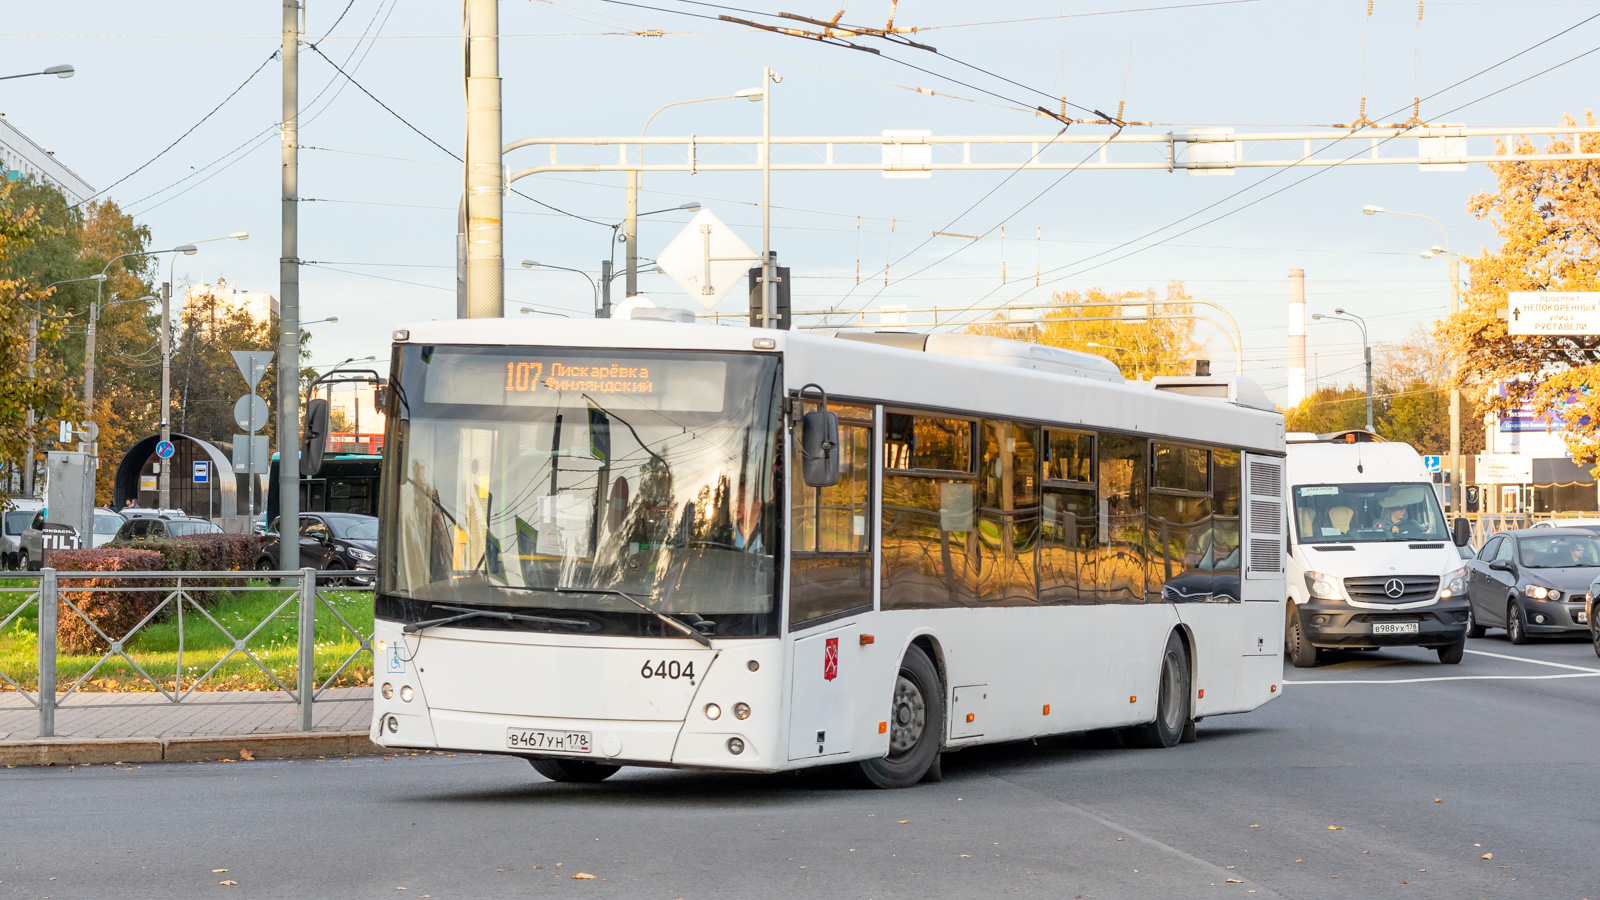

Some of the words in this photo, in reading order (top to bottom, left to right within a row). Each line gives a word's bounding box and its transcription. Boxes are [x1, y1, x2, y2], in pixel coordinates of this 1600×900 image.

[1534, 322, 1588, 331] РУСТАВЕЛИ
[505, 362, 543, 391] 107
[550, 362, 649, 379] Пискарёвка
[545, 376, 653, 393] Финляндский
[640, 659, 695, 680] 6404
[511, 731, 564, 749] В467УН
[566, 733, 587, 746] 178
